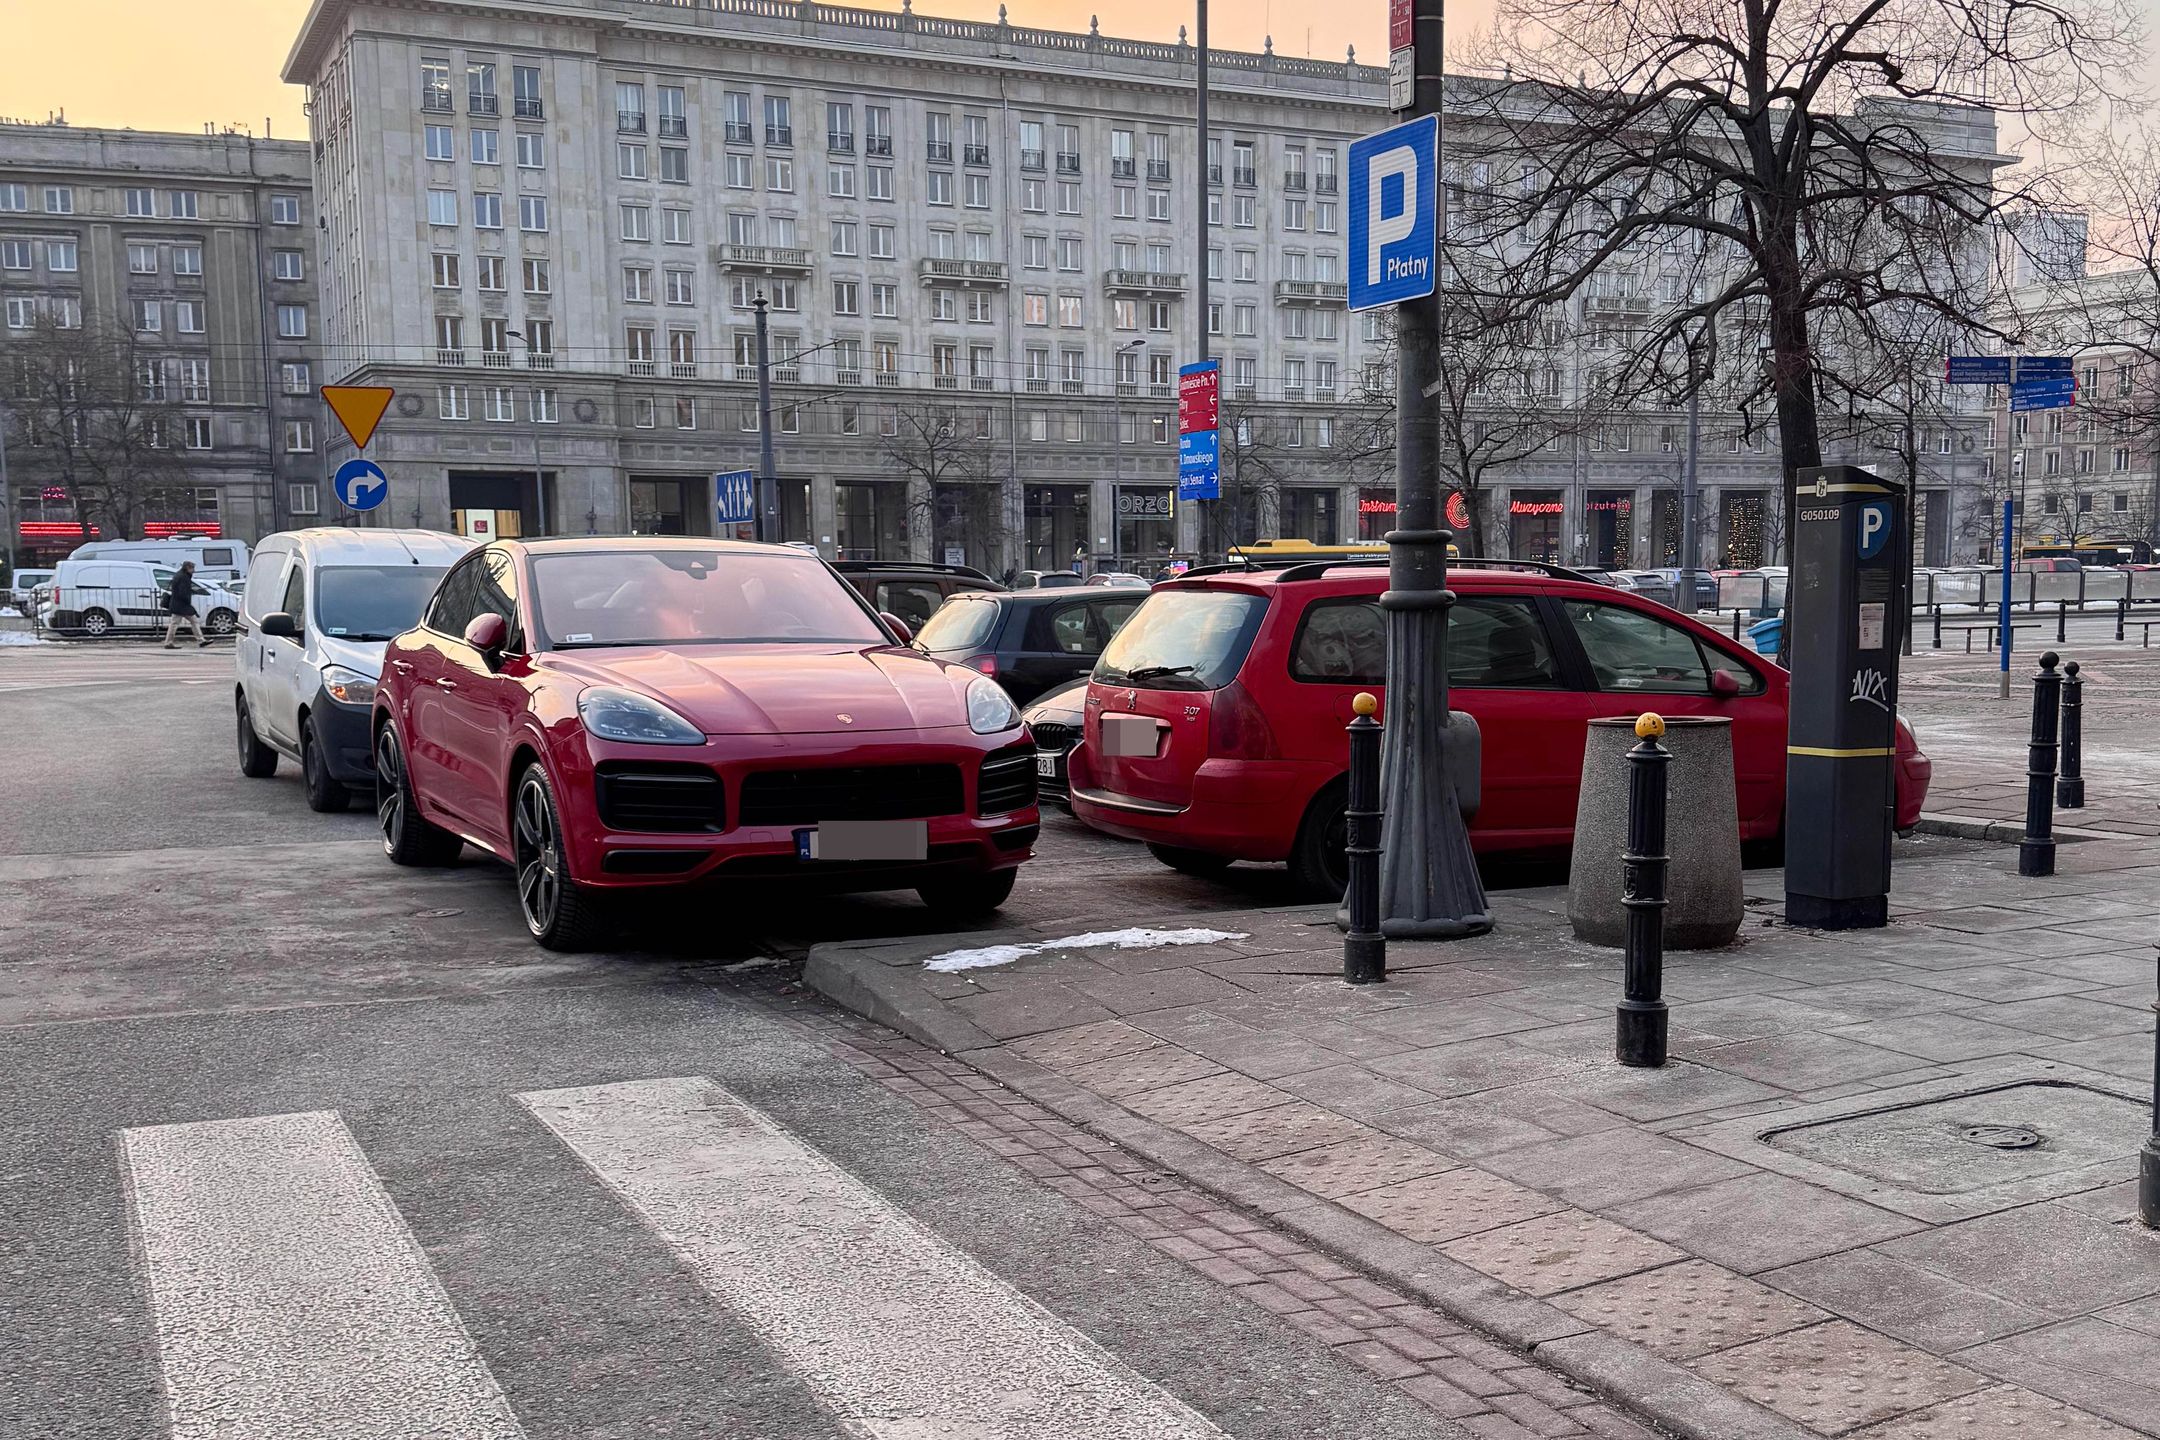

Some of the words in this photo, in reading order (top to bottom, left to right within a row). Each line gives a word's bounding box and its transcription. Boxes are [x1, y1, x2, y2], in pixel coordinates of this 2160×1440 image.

[1368, 145, 1418, 286] P
[1387, 255, 1429, 281] Płatny
[1119, 495, 1169, 513] ORZO
[1509, 500, 1564, 516] Muzyczne
[1800, 509, 1840, 522] G050109
[1863, 508, 1883, 548] P
[1852, 667, 1888, 701] NYX
[1183, 706, 1201, 715] 307
[800, 848, 809, 856] PL
